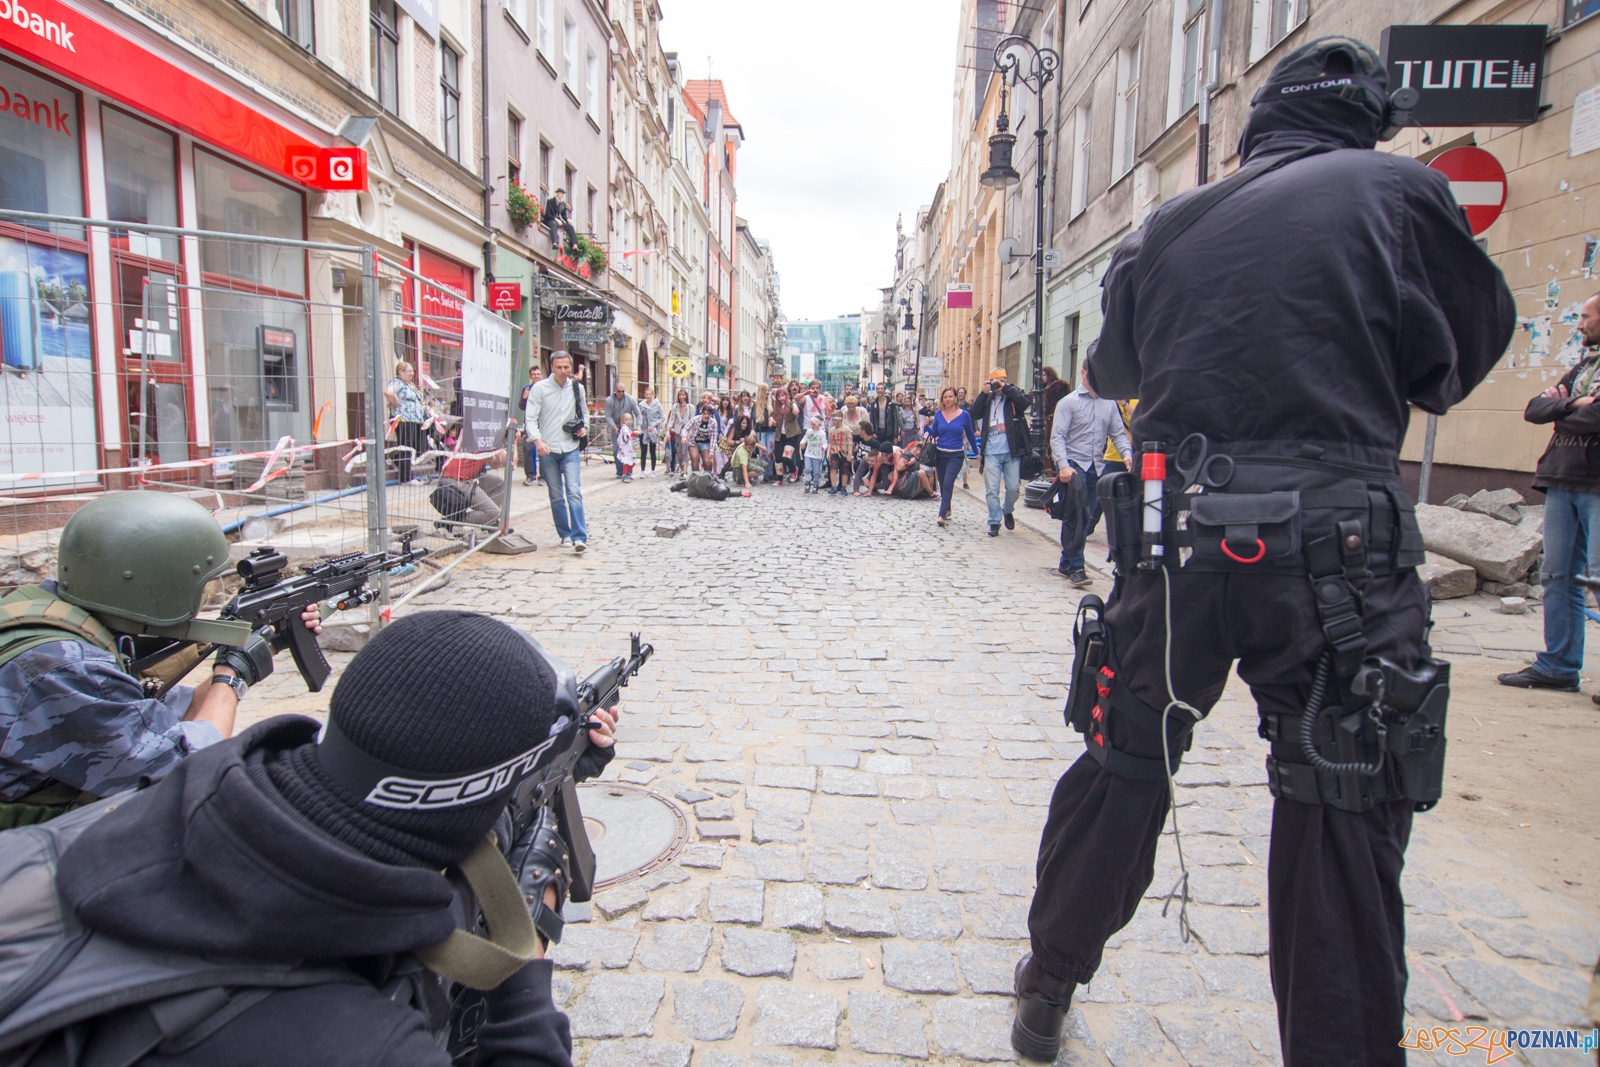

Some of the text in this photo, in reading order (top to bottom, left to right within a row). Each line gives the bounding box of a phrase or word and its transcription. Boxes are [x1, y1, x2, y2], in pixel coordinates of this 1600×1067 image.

[1281, 78, 1352, 94] CONTOUR
[557, 303, 604, 320] Donatello
[564, 332, 601, 341] TRATTORIA
[5, 411, 45, 426] większe
[364, 735, 558, 809] SCOTT
